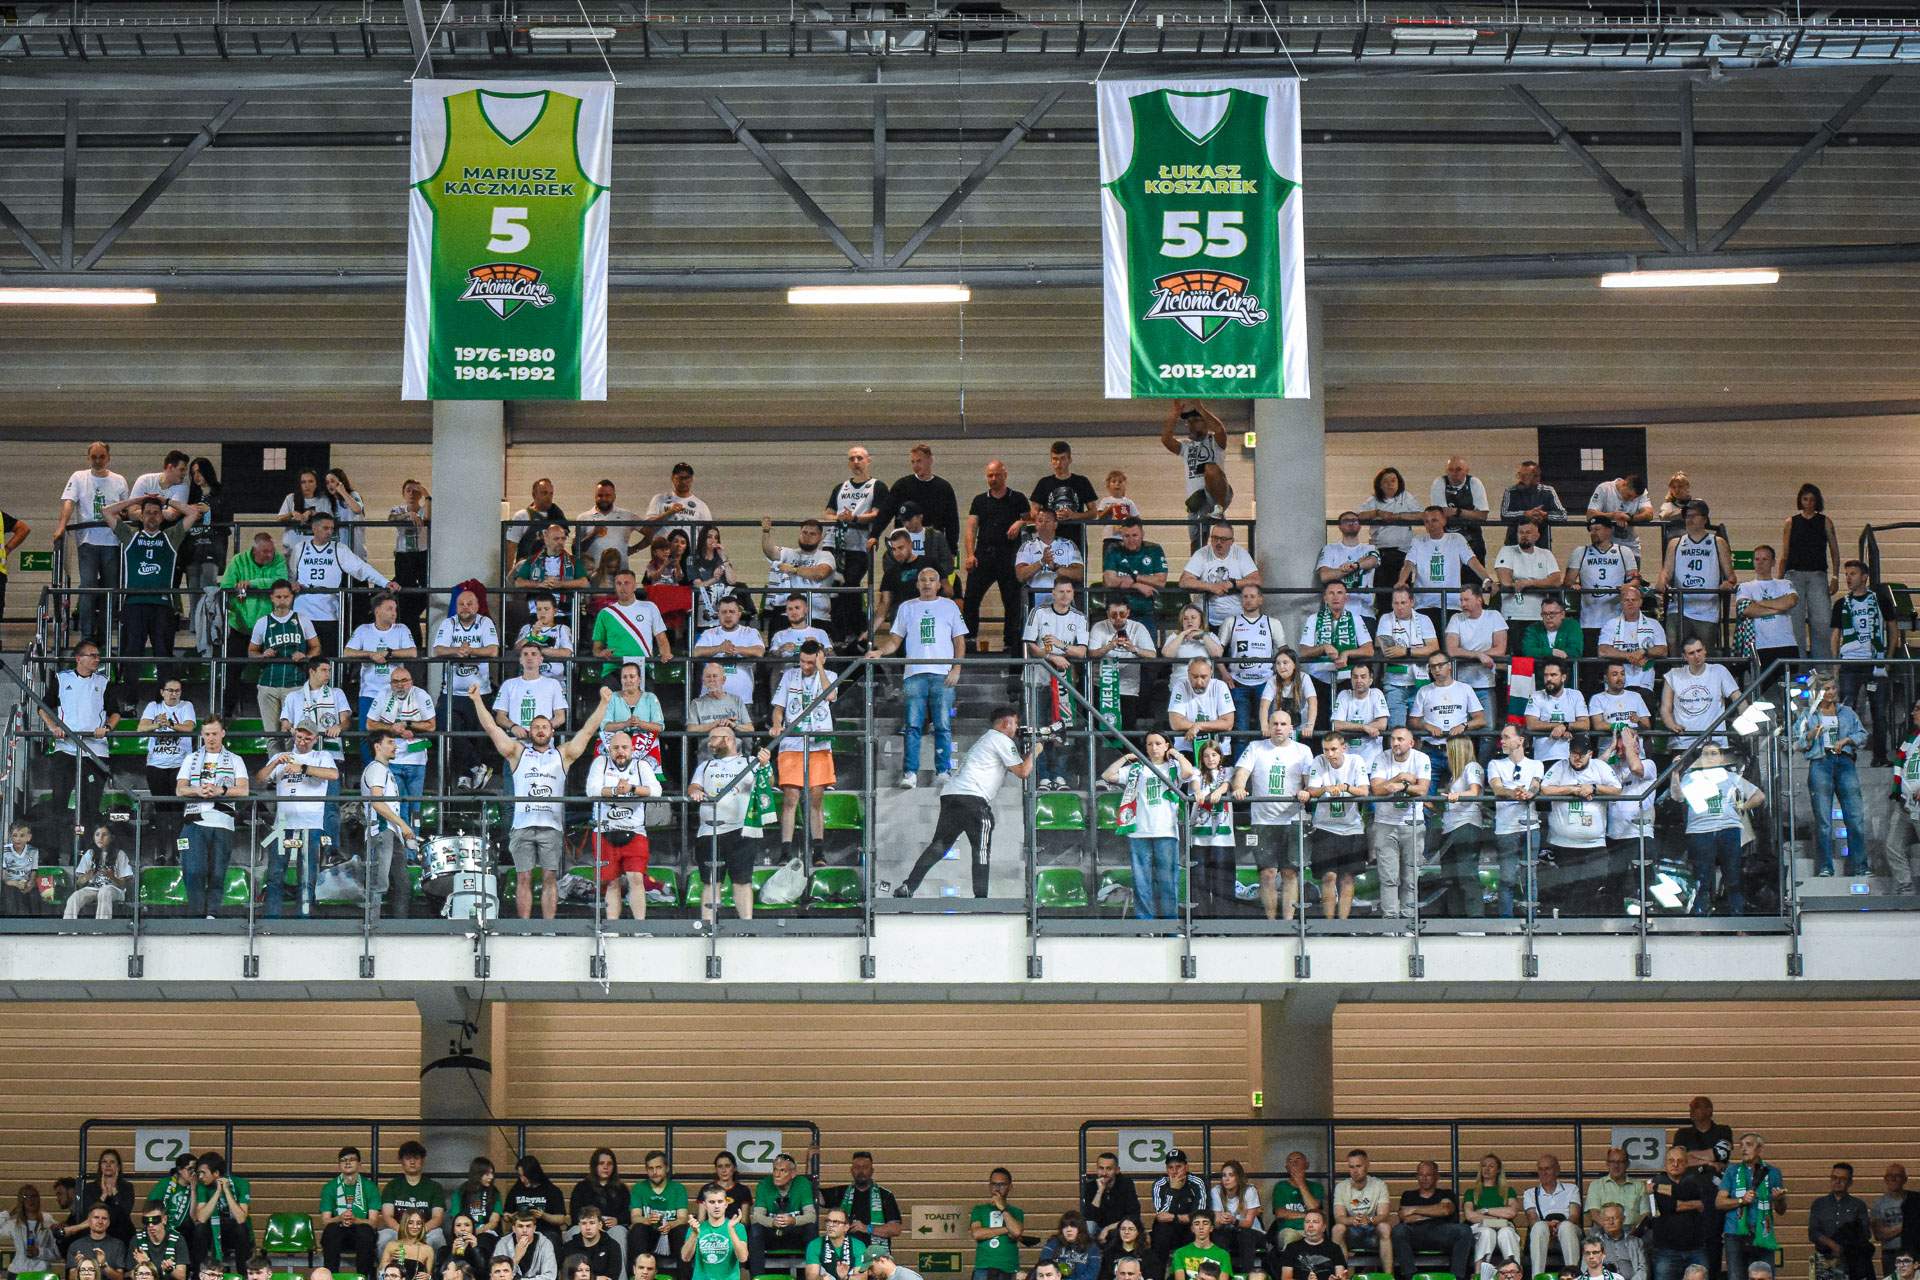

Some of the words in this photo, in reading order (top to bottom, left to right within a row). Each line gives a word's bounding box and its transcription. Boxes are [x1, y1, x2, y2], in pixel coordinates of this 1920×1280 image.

[463, 167, 558, 181] MARIUSZ
[1158, 165, 1242, 179] ŁUKASZ
[444, 182, 575, 196] KACZMAREK
[1144, 180, 1258, 194] KOSZAREK
[486, 206, 531, 254] 5
[1159, 211, 1248, 259] 55
[512, 278, 548, 297] Góra
[1147, 288, 1211, 316] Zielona
[1210, 288, 1258, 312] Góra
[454, 347, 556, 362] 1976-1980
[454, 366, 556, 381] 1984-1992
[1158, 364, 1257, 379] 2013-2021
[137, 538, 164, 548] WARSAW
[1681, 549, 1712, 557] WARSAW
[303, 557, 334, 566] WARSAW
[1587, 557, 1619, 566] WARSAW
[1687, 559, 1703, 570] 40
[310, 568, 325, 580] 23
[1430, 564, 1445, 576] NOT
[1598, 568, 1607, 580] 3
[1860, 618, 1868, 629] 3
[452, 635, 481, 644] WARSAW
[920, 626, 936, 639] NOT
[268, 633, 302, 647] LEGIA
[1101, 664, 1114, 709] ZIELONI
[520, 707, 536, 720] NOT
[1269, 774, 1285, 789] NOT
[611, 809, 630, 818] LOTTO
[145, 1138, 184, 1162] C2
[736, 1140, 776, 1163] C2
[1128, 1138, 1167, 1162] C3
[1622, 1136, 1659, 1161] C3
[924, 1212, 961, 1221] TOALETY
[699, 1238, 730, 1249] Zastal
